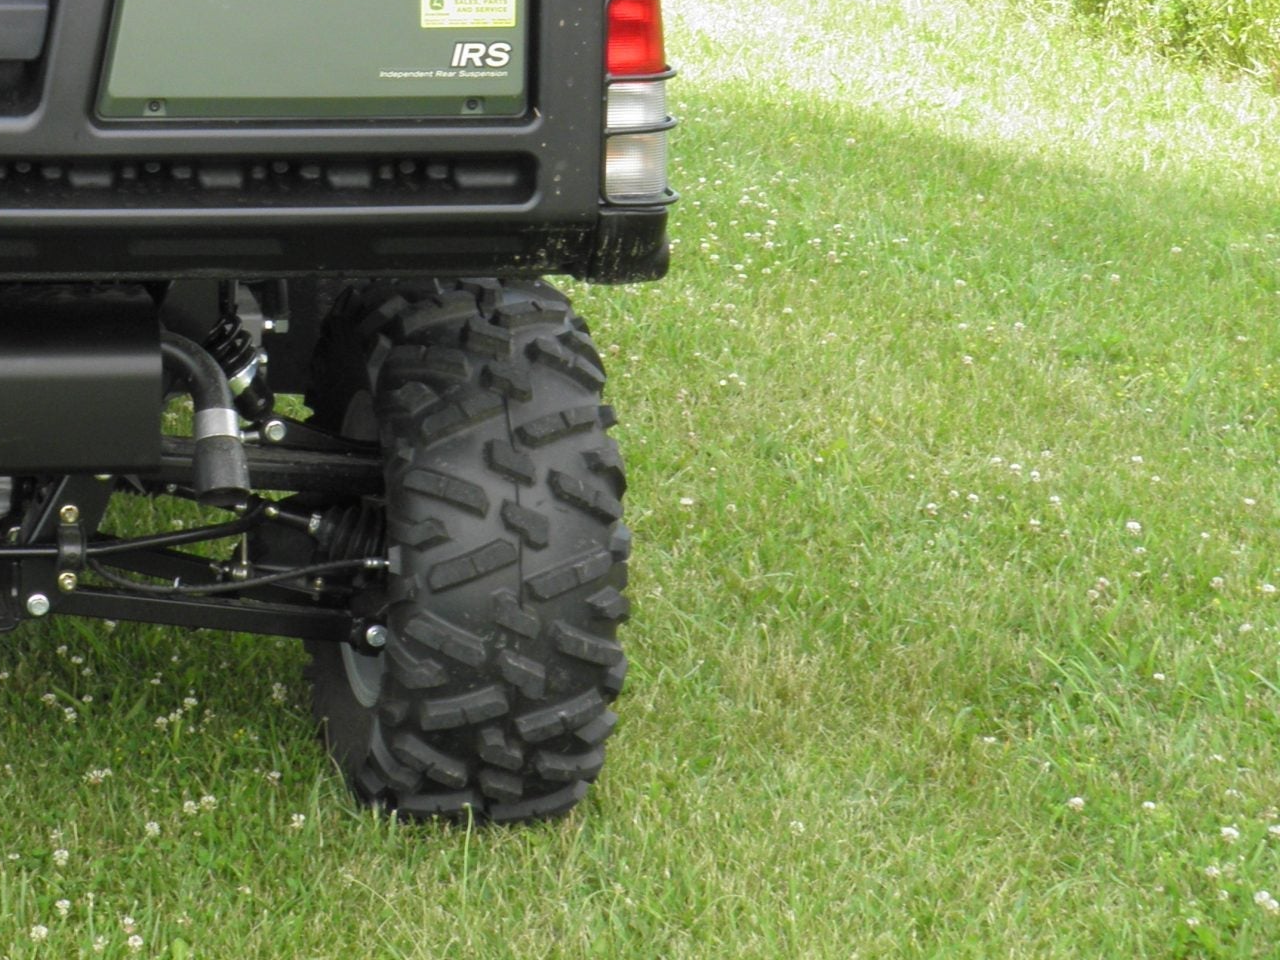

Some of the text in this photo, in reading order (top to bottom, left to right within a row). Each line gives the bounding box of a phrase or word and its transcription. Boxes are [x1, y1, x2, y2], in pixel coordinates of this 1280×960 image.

[450, 42, 512, 68] IRS
[379, 70, 508, 79] Independent Rear Suspension
